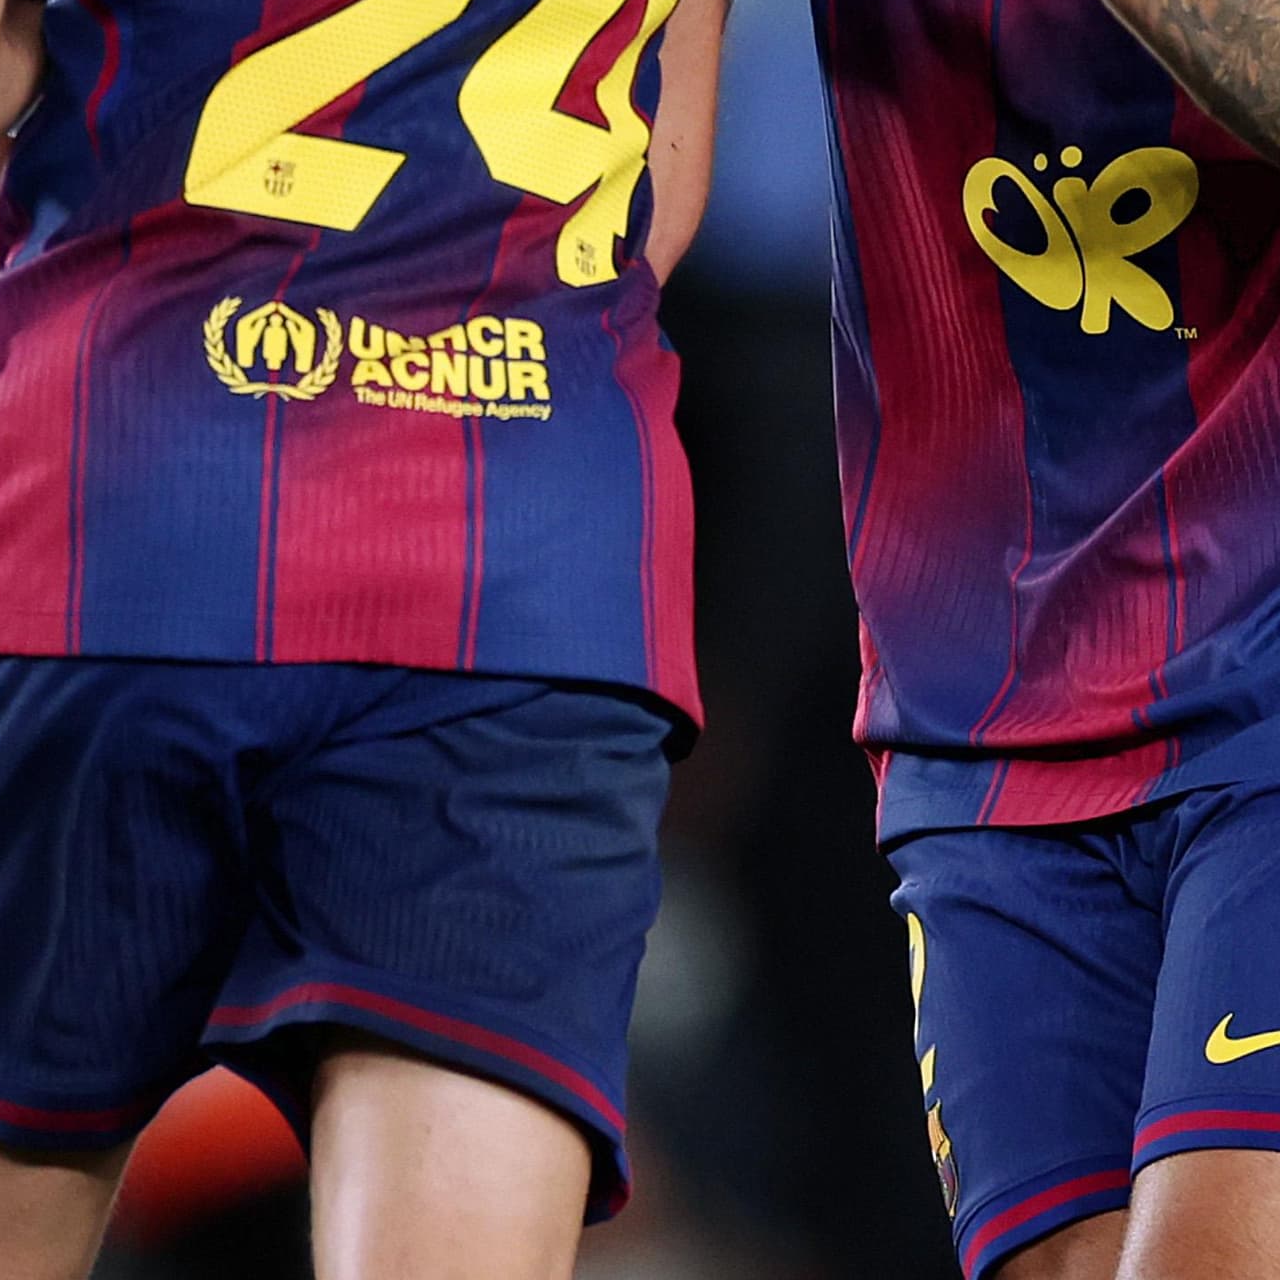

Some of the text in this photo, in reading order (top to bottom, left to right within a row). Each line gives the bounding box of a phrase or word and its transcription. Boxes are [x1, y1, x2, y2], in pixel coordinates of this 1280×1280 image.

[1174, 327, 1198, 339] TM
[351, 350, 552, 400] ACNUR
[354, 387, 386, 406] The
[414, 391, 483, 418] Refugee
[485, 401, 552, 421] Agency
